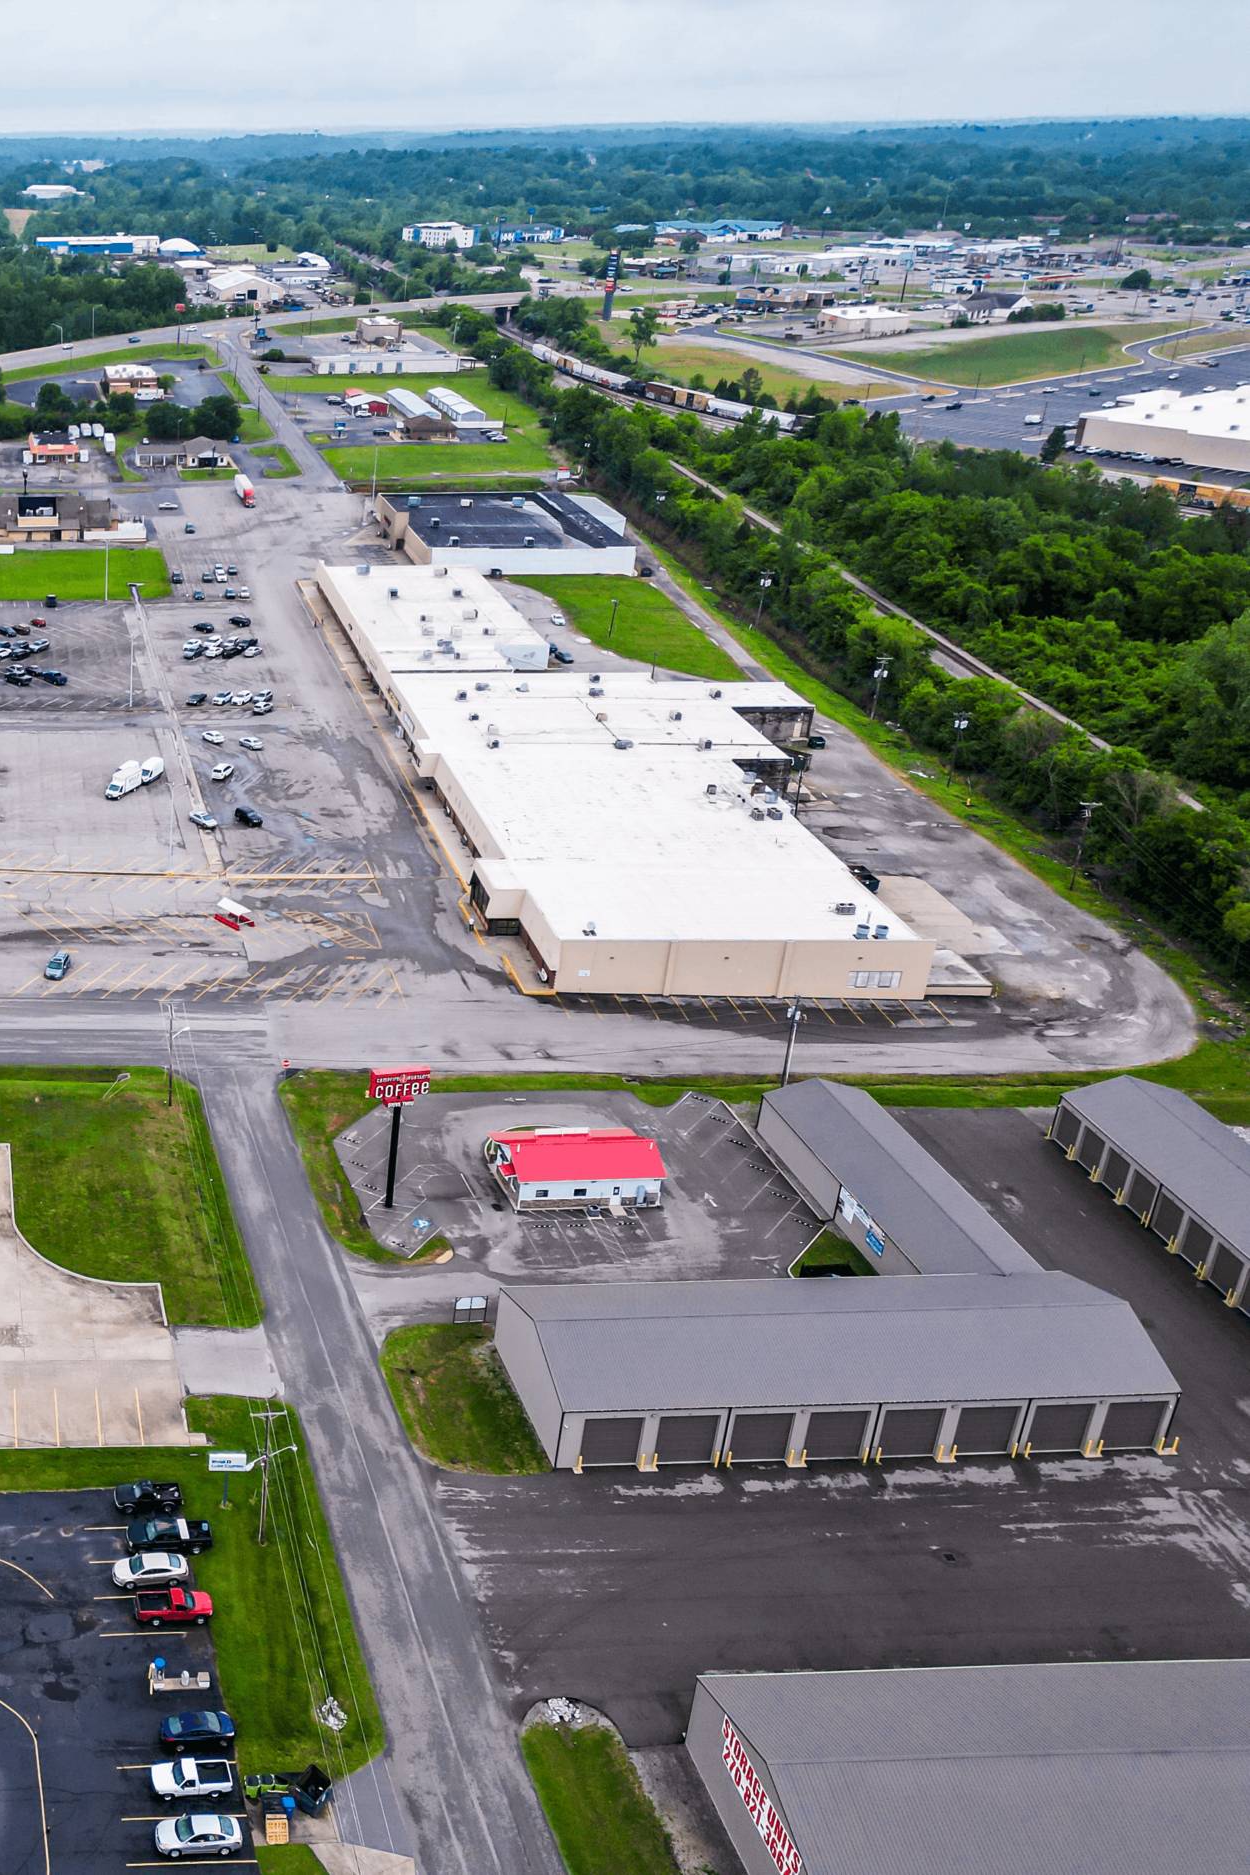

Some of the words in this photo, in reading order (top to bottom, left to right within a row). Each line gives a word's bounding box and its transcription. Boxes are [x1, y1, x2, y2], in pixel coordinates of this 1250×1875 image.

[723, 1718, 768, 1813] STORAGE
[767, 1804, 801, 1874] UNITS
[723, 1744, 792, 1875] 270-821-3667
